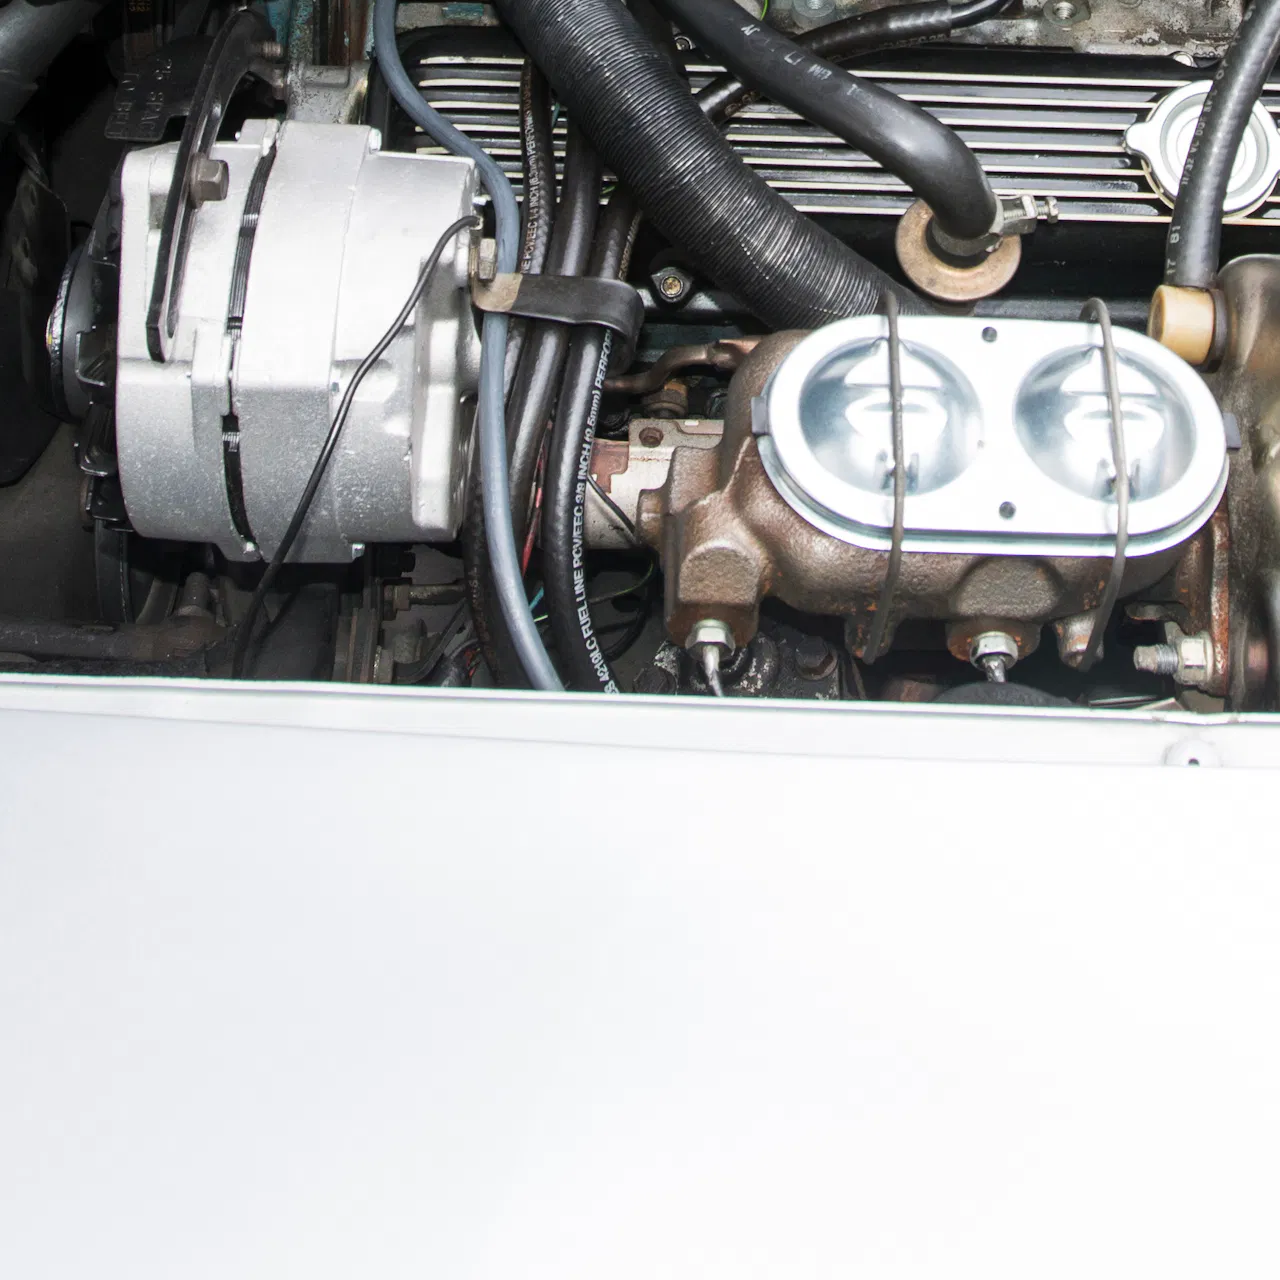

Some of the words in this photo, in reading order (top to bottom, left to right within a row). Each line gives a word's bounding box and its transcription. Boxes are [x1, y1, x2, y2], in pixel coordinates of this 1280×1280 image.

[595, 328, 613, 389] PERFOR
[584, 390, 601, 442] (9.5mm)
[577, 442, 593, 480] INCH
[575, 482, 587, 504] 3/8
[572, 506, 584, 568] PCV/EEC
[573, 568, 586, 602] LINE
[577, 600, 593, 639] FUEL
